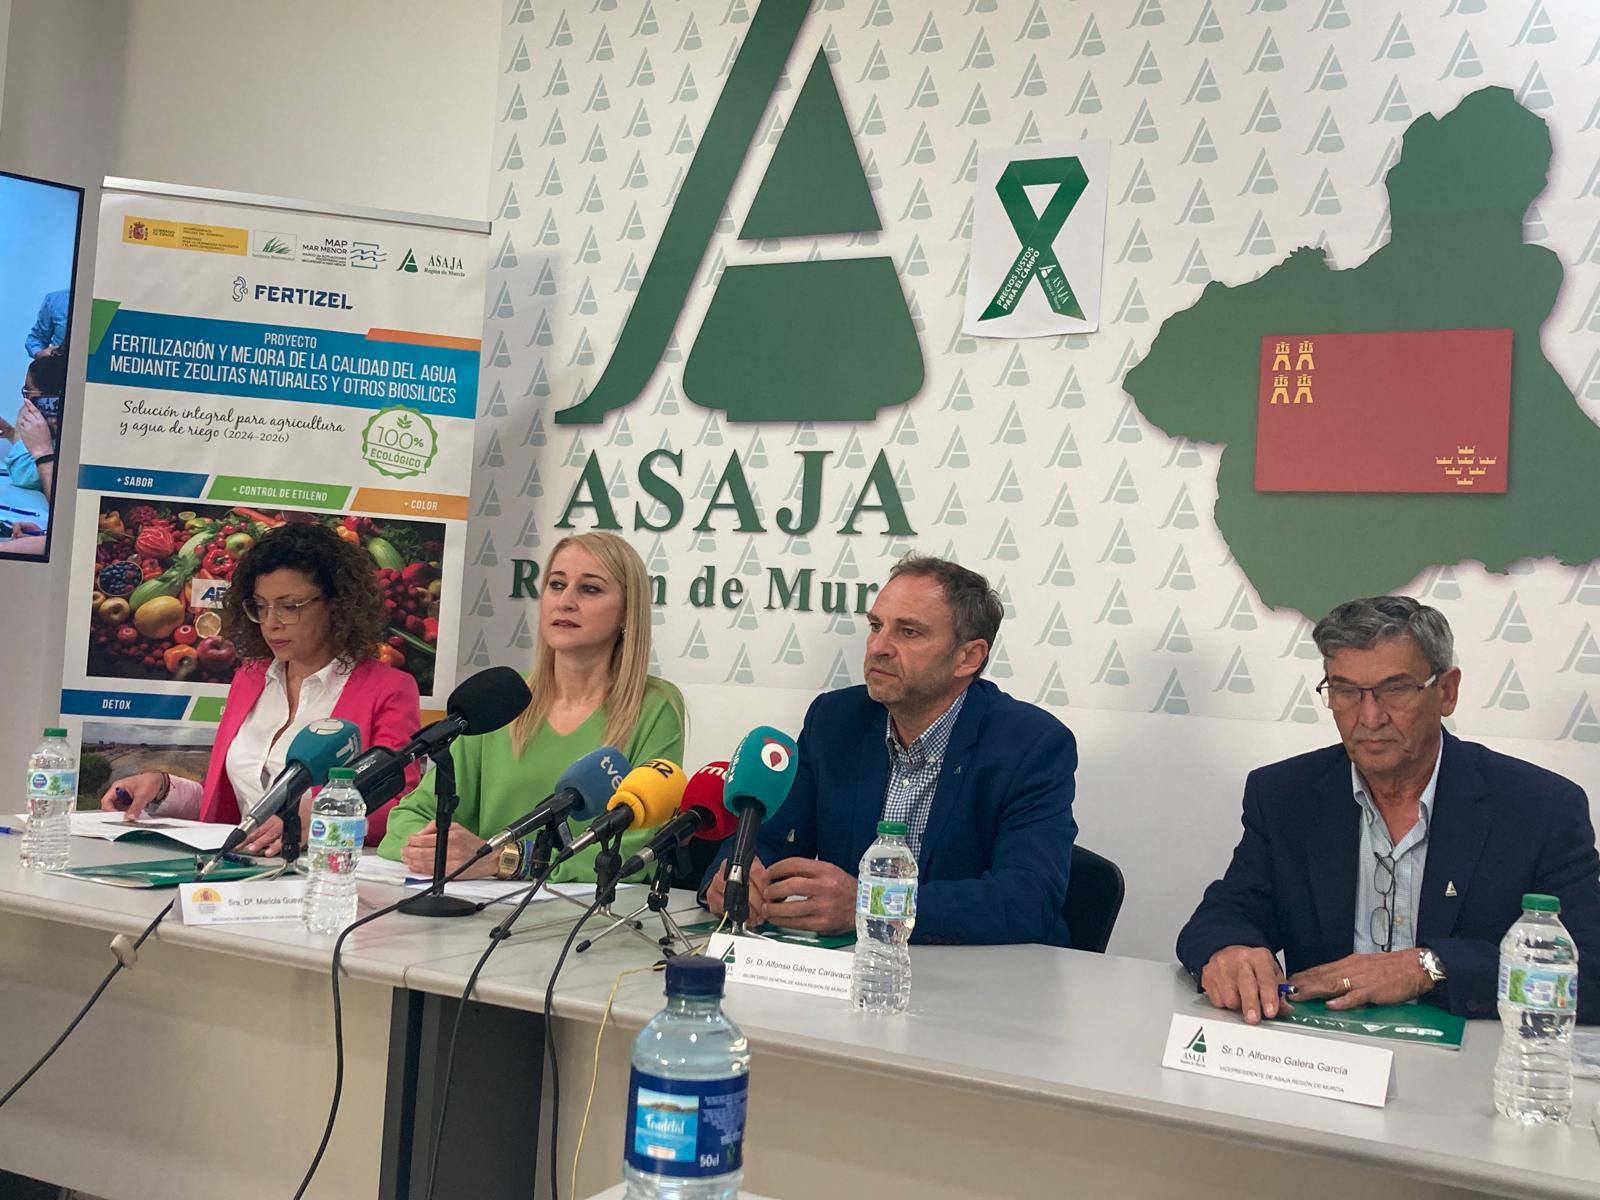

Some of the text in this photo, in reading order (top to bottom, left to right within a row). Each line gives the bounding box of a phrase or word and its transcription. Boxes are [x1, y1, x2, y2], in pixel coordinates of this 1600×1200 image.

[302, 244, 348, 255] MAR MENOR
[325, 239, 348, 247] MAP
[428, 255, 463, 270] ASAJA
[996, 246, 1034, 306] PRECIOS JUSTOS
[1002, 250, 1040, 311] PARA EL CAMPO
[254, 284, 353, 310] FERTIZEL
[1052, 276, 1070, 304] ASAJA
[264, 332, 317, 348] PROYECTO
[112, 333, 457, 384] FERTILIZACIÓN Y MEJORA DE LA CALIDAD DEL AGUA
[110, 355, 457, 404] MEDIANTE ZEOLITAS NATURALES Y OTROS BIOSILICES
[121, 400, 346, 433] Solución integral para agricultura
[119, 420, 290, 443] y agua de riego (2024-2026)
[376, 426, 424, 450] 100%
[370, 447, 422, 468] ECOLÓGICO
[124, 476, 154, 487] SABOR
[239, 485, 276, 497] CONTROL
[279, 488, 291, 498] DE
[292, 489, 328, 501] ETILENO
[554, 447, 919, 537] ASAJA
[411, 499, 438, 511] COLOR
[689, 564, 744, 609] de
[764, 566, 878, 615] Mur
[102, 698, 131, 710] DETOX
[600, 755, 623, 791] tve
[745, 956, 852, 979] Sr. D. Alfonso Gálvez Caravaca
[1184, 1052, 1205, 1063] ASAJA
[1221, 1044, 1348, 1075] Sr. D. Alfonso Galera García
[1219, 1066, 1264, 1079] VICEPRESIDENTE
[1292, 1078, 1313, 1088] REGIÓN
[1322, 1084, 1345, 1093] MURCIA
